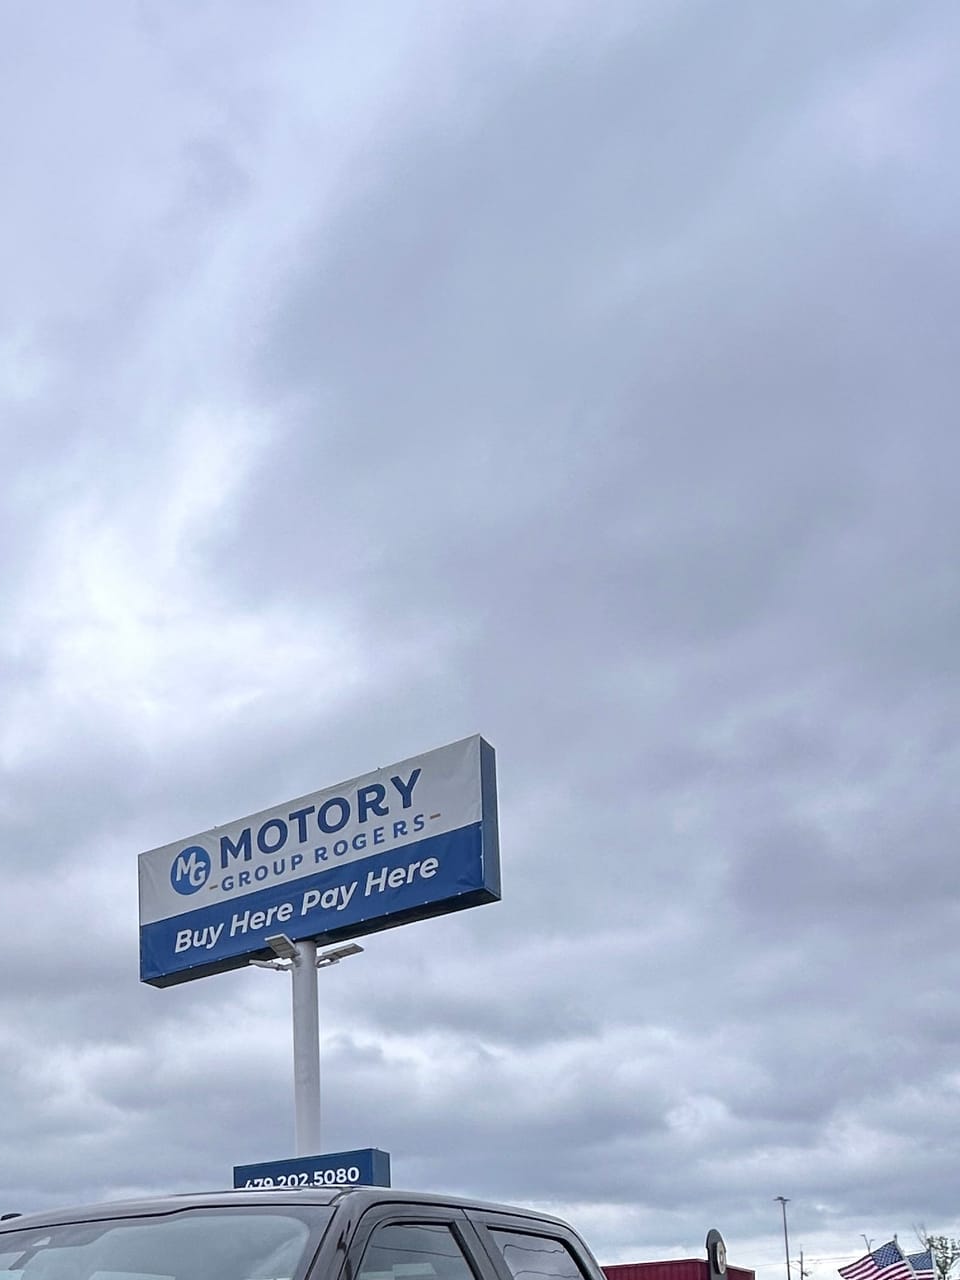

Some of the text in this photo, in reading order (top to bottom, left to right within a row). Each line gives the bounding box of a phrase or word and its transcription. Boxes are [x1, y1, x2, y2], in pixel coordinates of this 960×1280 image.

[220, 768, 422, 869] MOTORY
[221, 813, 426, 892] GROUP ROGERS
[174, 855, 440, 954] Buy Here Pay Here
[245, 1166, 360, 1188] 479202.5080
